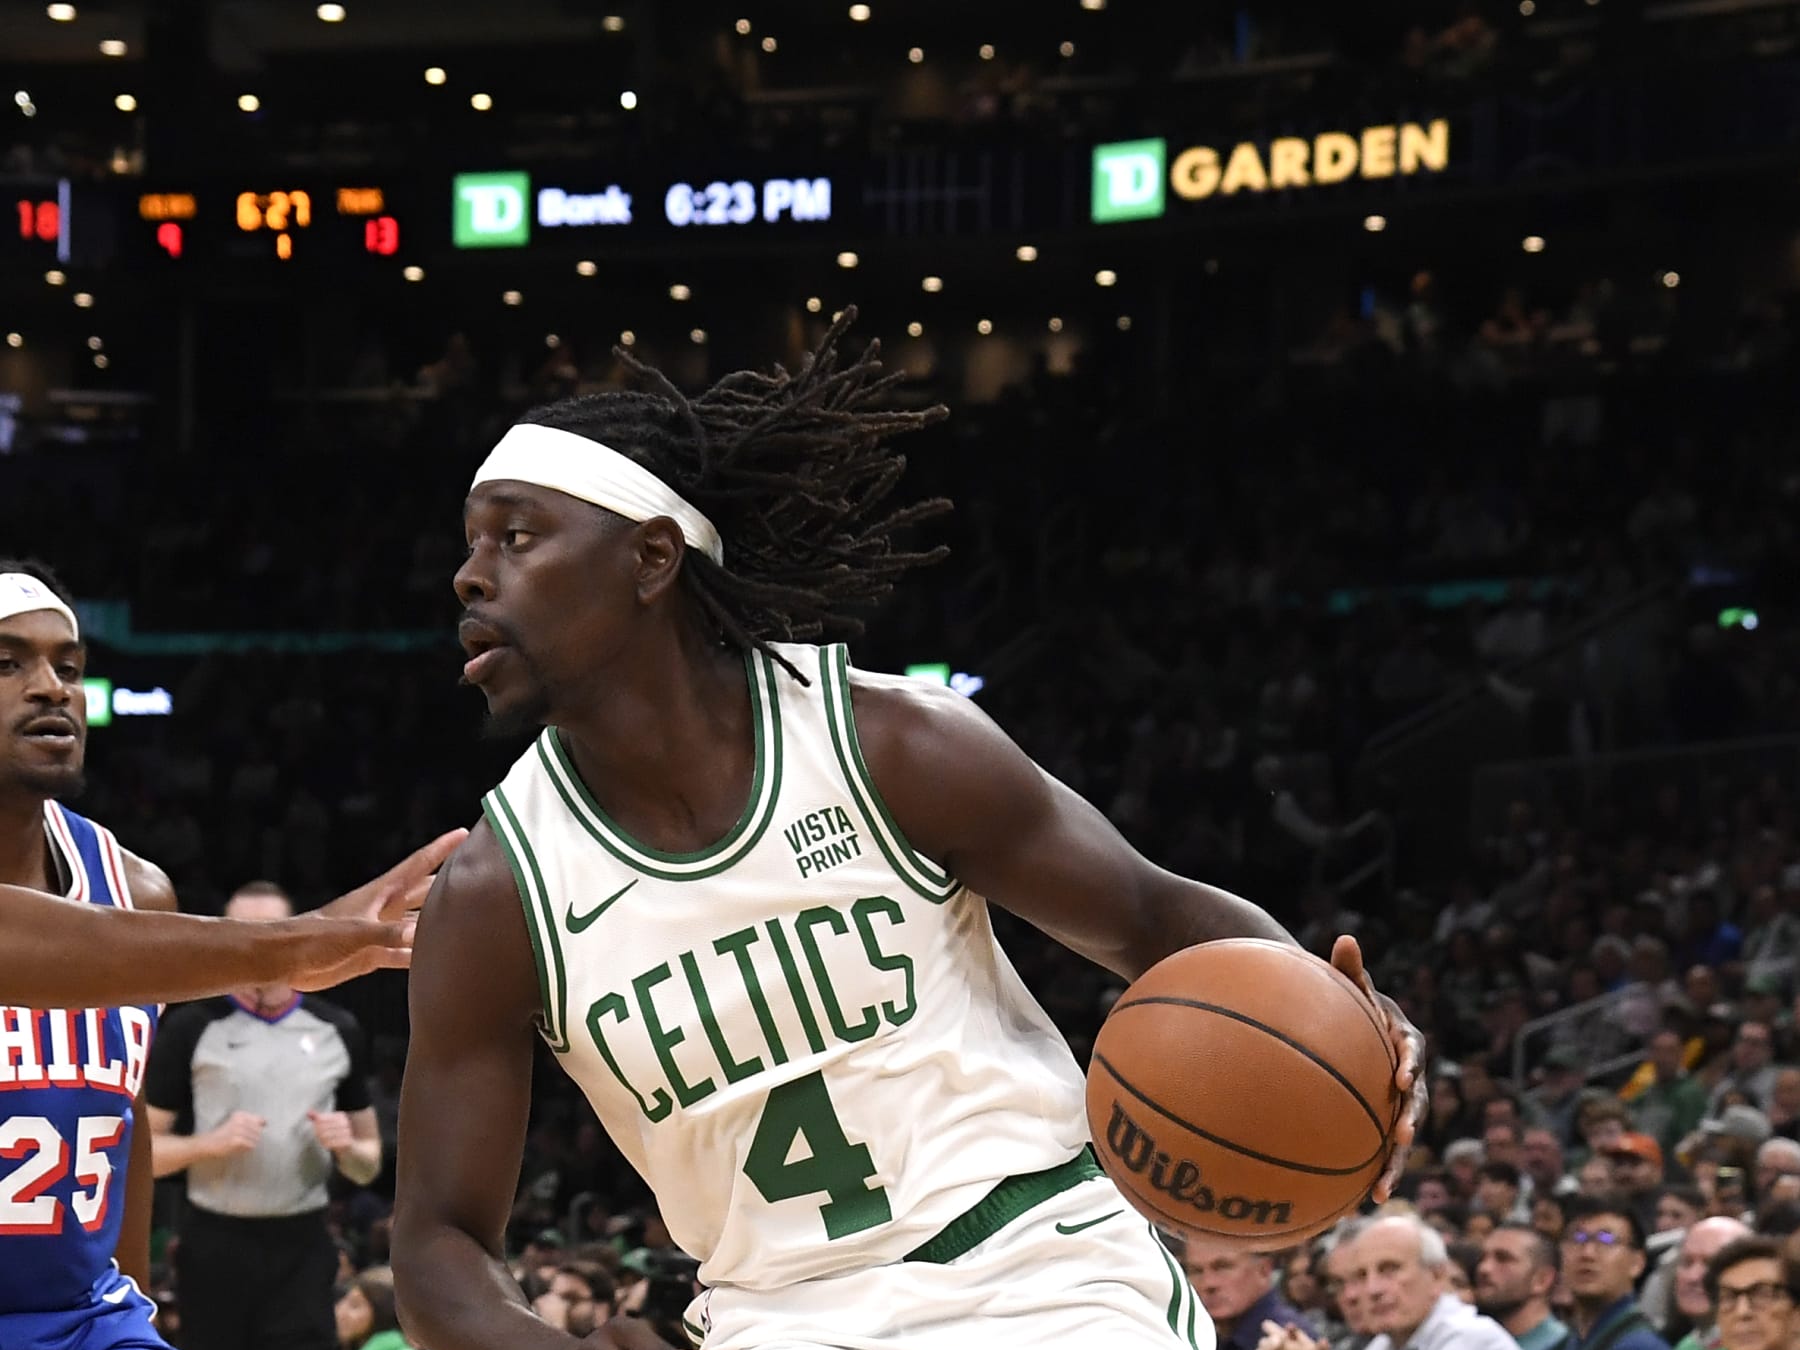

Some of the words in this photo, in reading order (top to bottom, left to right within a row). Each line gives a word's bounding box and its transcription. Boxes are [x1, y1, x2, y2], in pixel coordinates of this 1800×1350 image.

[1099, 152, 1160, 206] TD
[1170, 118, 1449, 200] GARDEN
[237, 190, 310, 231] 6:27
[460, 185, 523, 233] TD
[537, 185, 632, 226] Bank
[665, 181, 756, 226] 6:23
[763, 177, 831, 223] PM
[783, 805, 856, 855] VISTA
[796, 833, 862, 879] PRINT
[585, 895, 917, 1123] CELTICS
[0, 1116, 127, 1234] 25
[742, 1069, 893, 1241] 4
[1107, 1098, 1293, 1225] Wilson
